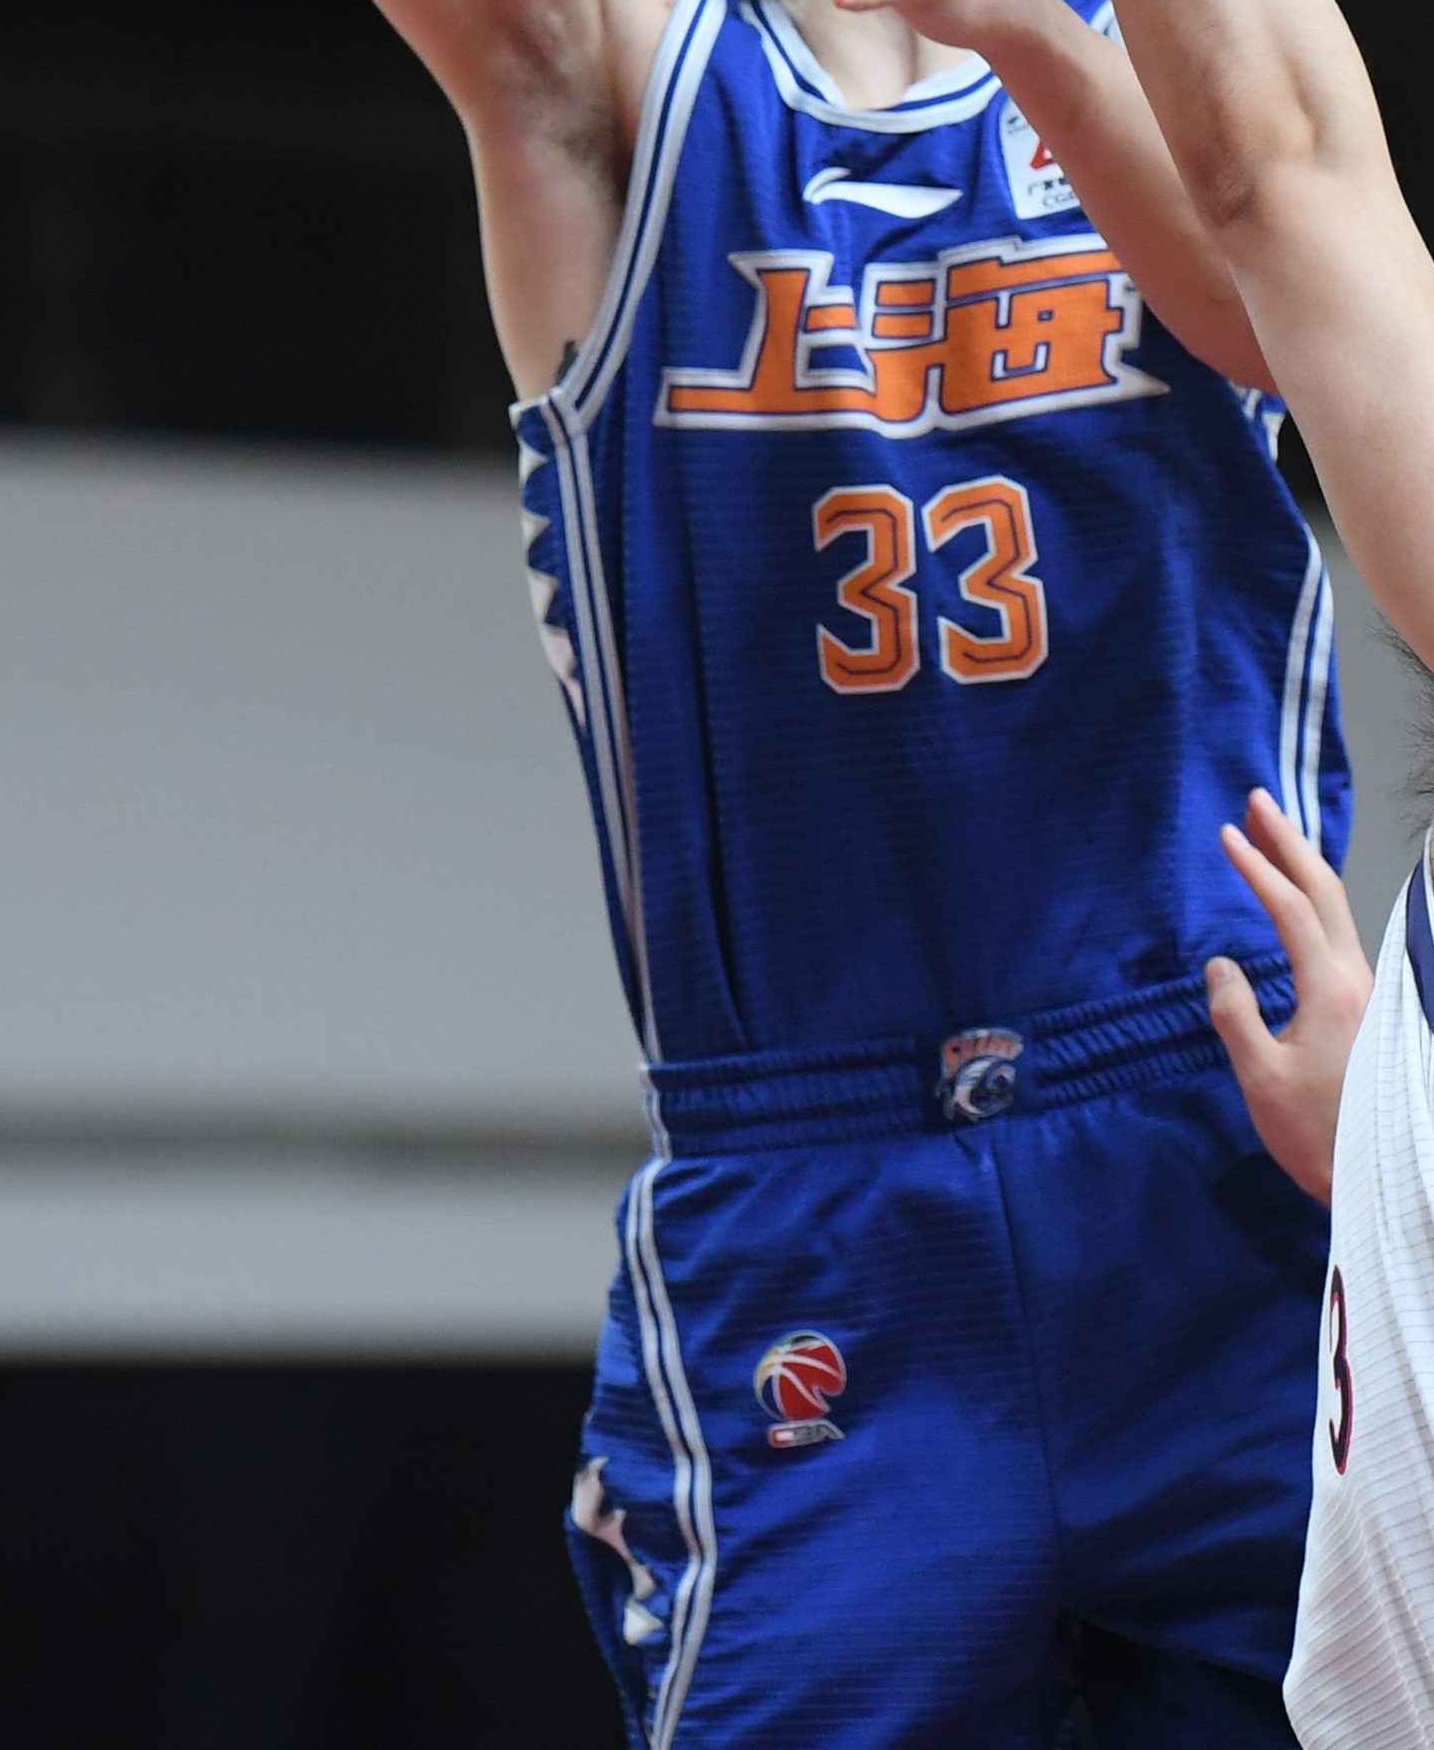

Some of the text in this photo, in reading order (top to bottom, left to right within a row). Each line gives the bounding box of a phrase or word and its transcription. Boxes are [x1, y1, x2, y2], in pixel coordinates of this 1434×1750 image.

[654, 234, 1170, 440] 上海
[812, 475, 1049, 695] 33
[1329, 1264, 1354, 1476] 3
